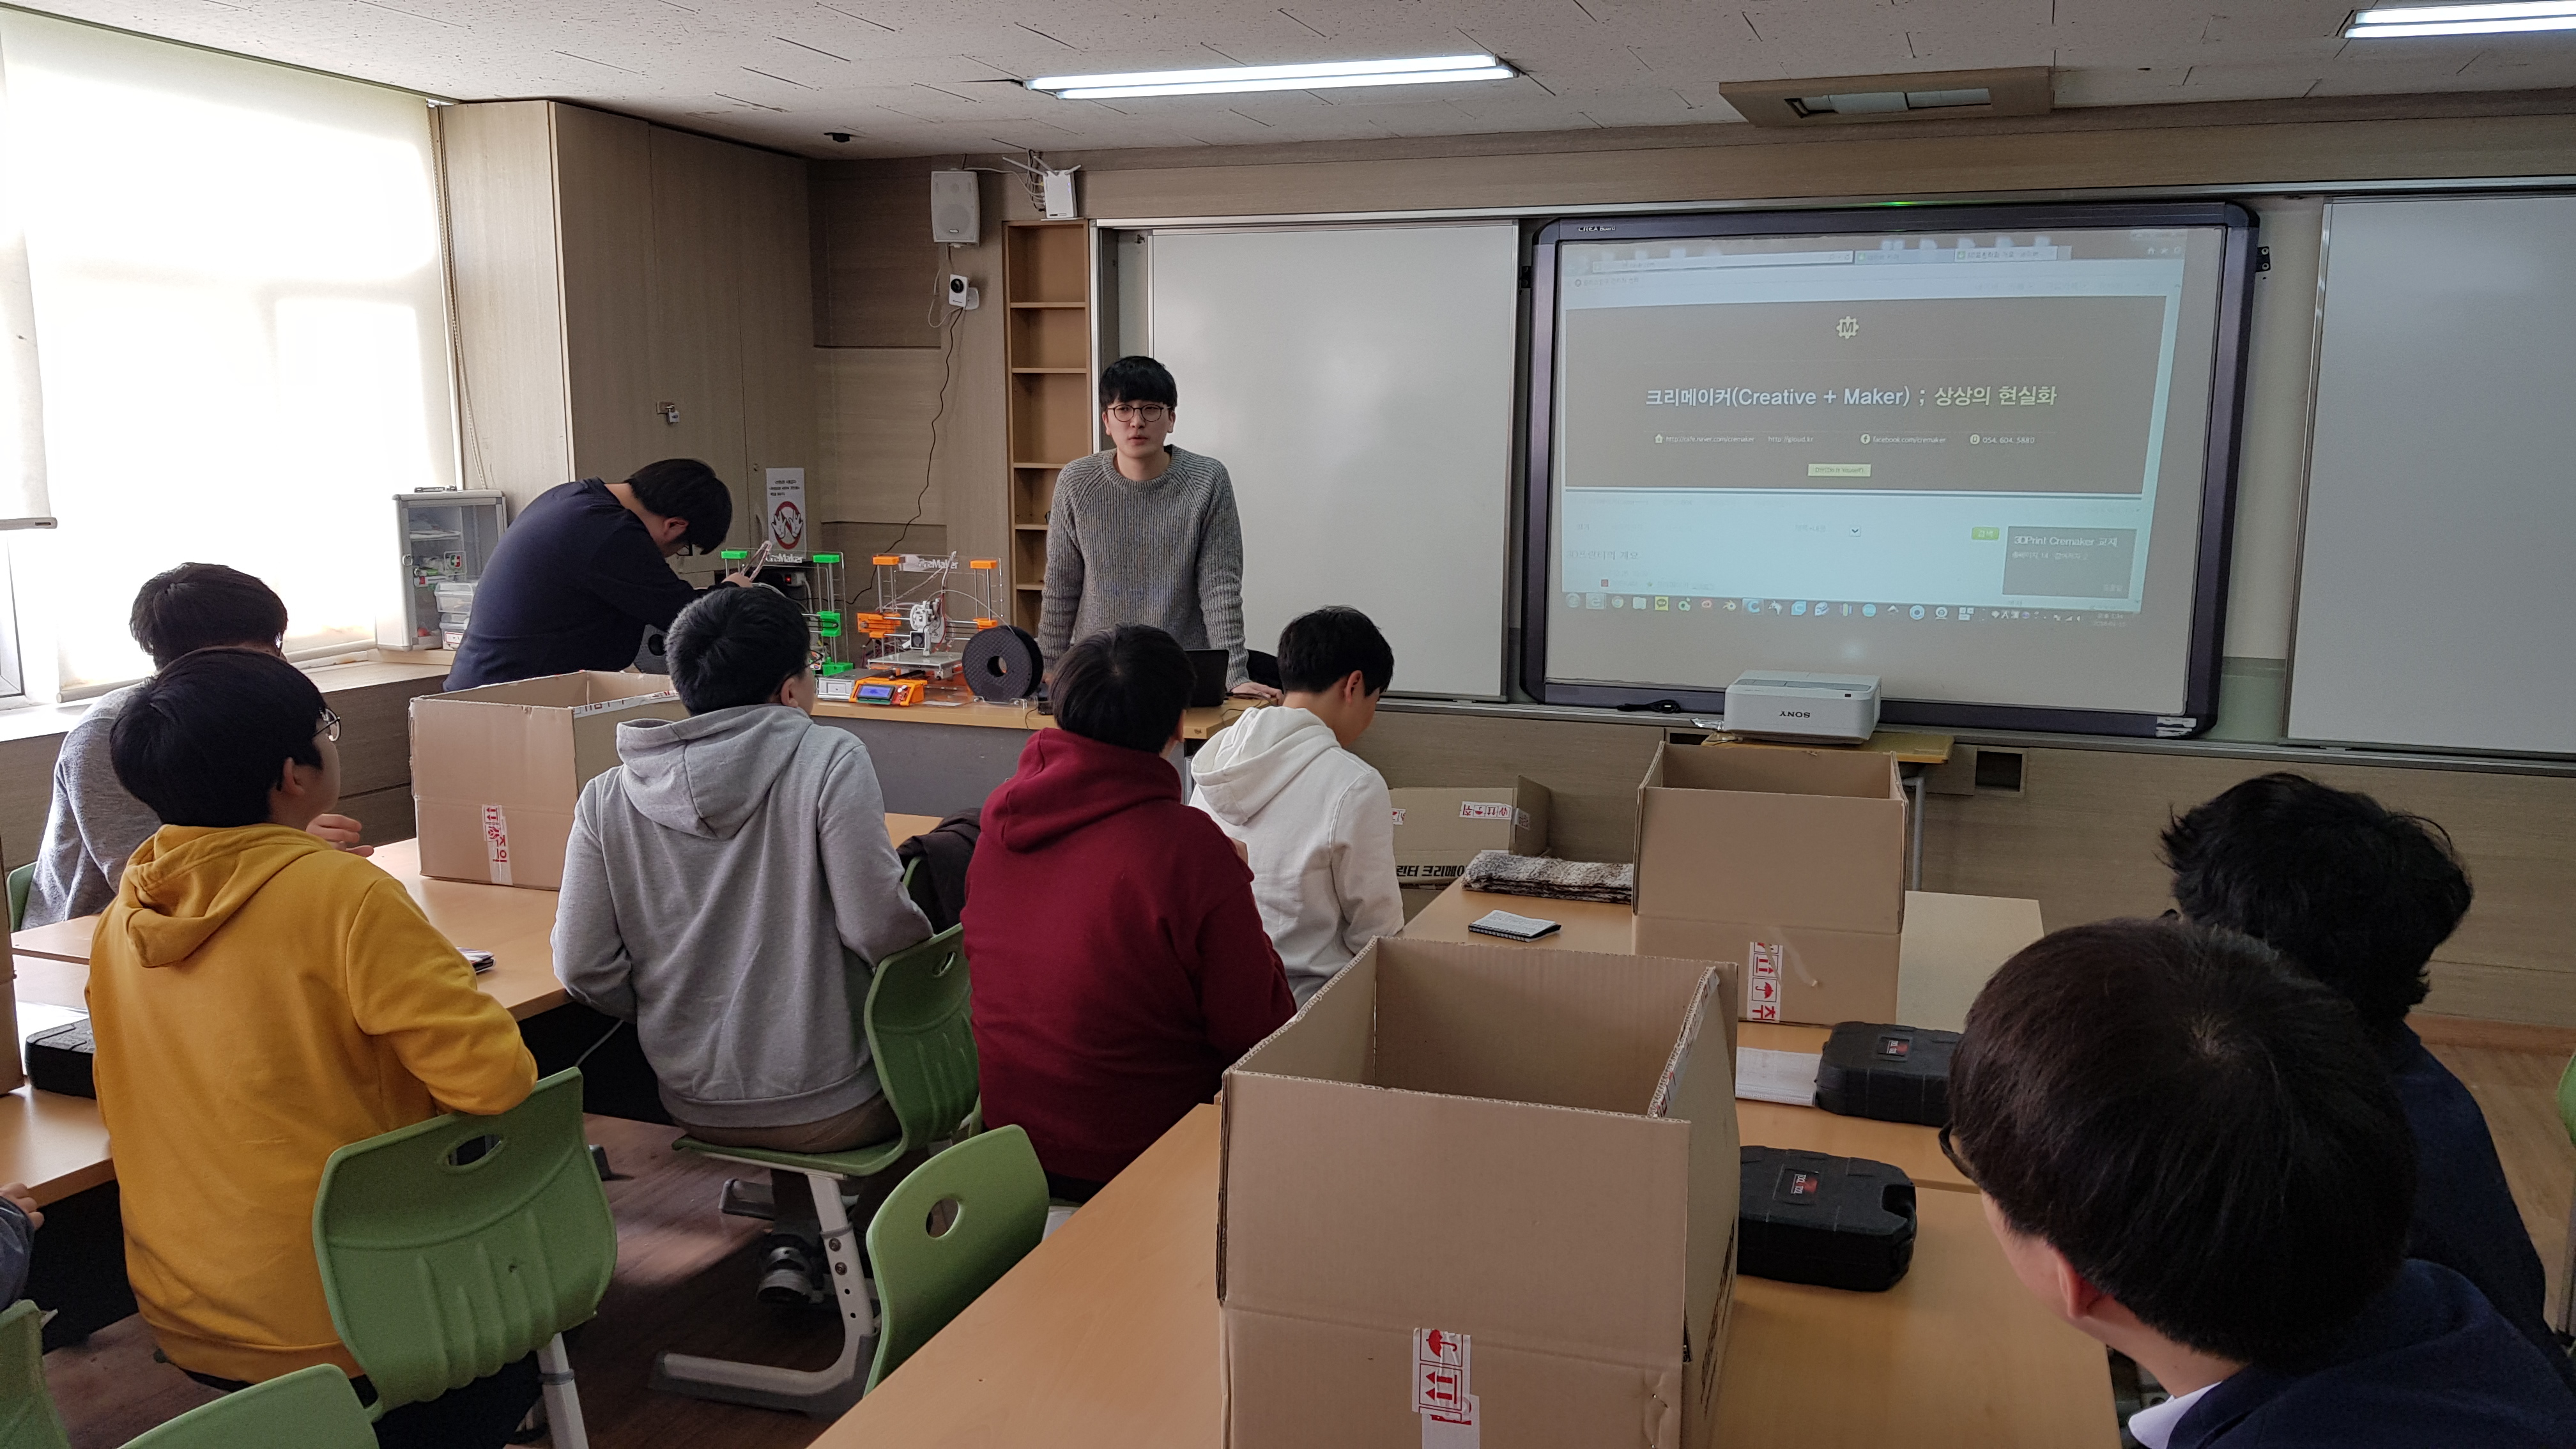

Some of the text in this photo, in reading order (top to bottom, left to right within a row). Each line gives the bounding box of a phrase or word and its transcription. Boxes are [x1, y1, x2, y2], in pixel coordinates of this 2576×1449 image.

[1646, 388, 1817, 408] 크리메이커(Creative
[1843, 386, 1910, 408] Maker)
[1935, 386, 1991, 406] 상상의
[1998, 385, 2058, 407] 현실화
[2013, 535, 2047, 545] 3DPrint
[2049, 536, 2095, 546] Cremaker
